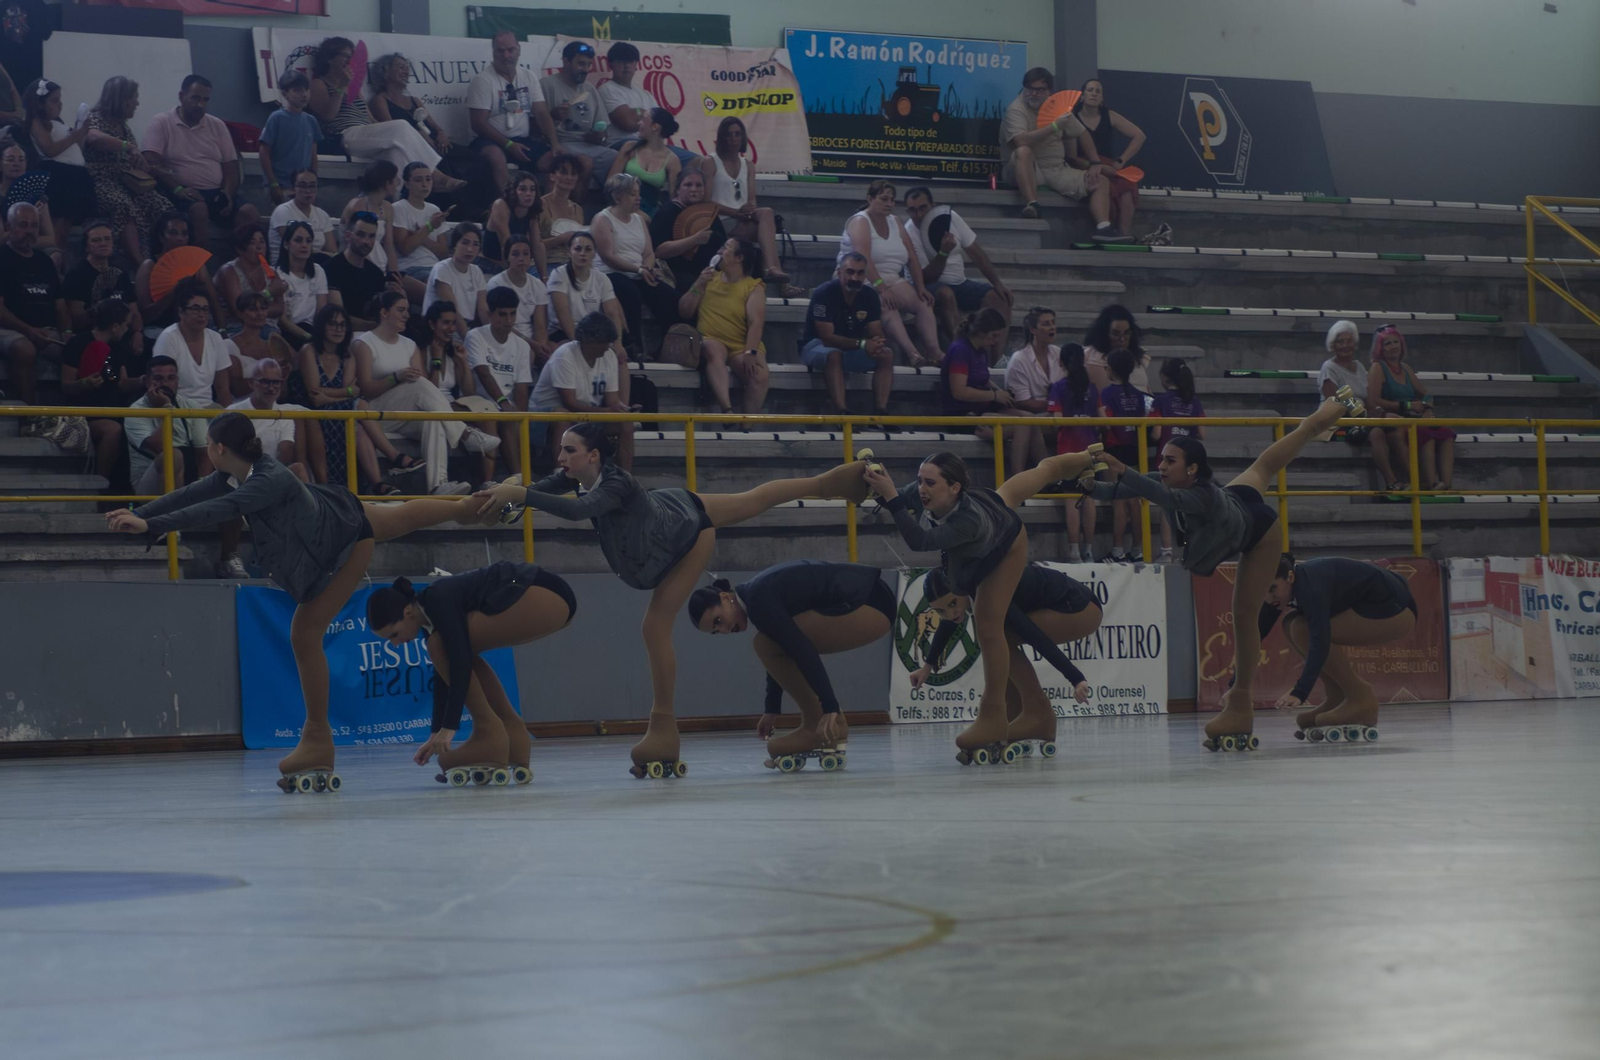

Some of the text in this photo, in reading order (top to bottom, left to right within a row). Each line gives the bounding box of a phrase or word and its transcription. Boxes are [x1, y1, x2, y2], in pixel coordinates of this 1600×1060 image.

[805, 34, 1011, 73] J. Ramón Rodríguez
[721, 93, 794, 110] DUNLOP
[884, 125, 938, 139] Todo tipo de
[809, 137, 849, 148] SBROCES
[850, 139, 907, 151] FORESTALES
[908, 141, 914, 151] Y
[915, 142, 973, 154] PREPARADOS
[975, 145, 987, 154] DE
[592, 381, 606, 396] 10
[910, 688, 925, 701] Os
[928, 688, 967, 703] Corzos,
[969, 688, 976, 700] 6
[1097, 684, 1146, 701] (Ourense)
[932, 706, 950, 719] 988
[953, 706, 967, 719] 27
[1073, 705, 1097, 716] Fax:
[1098, 704, 1116, 716] 988
[1118, 703, 1130, 715] 27
[1133, 703, 1146, 715] 48
[1147, 702, 1160, 714] 70
[275, 728, 295, 738] Avda.
[373, 722, 395, 733] 32500
